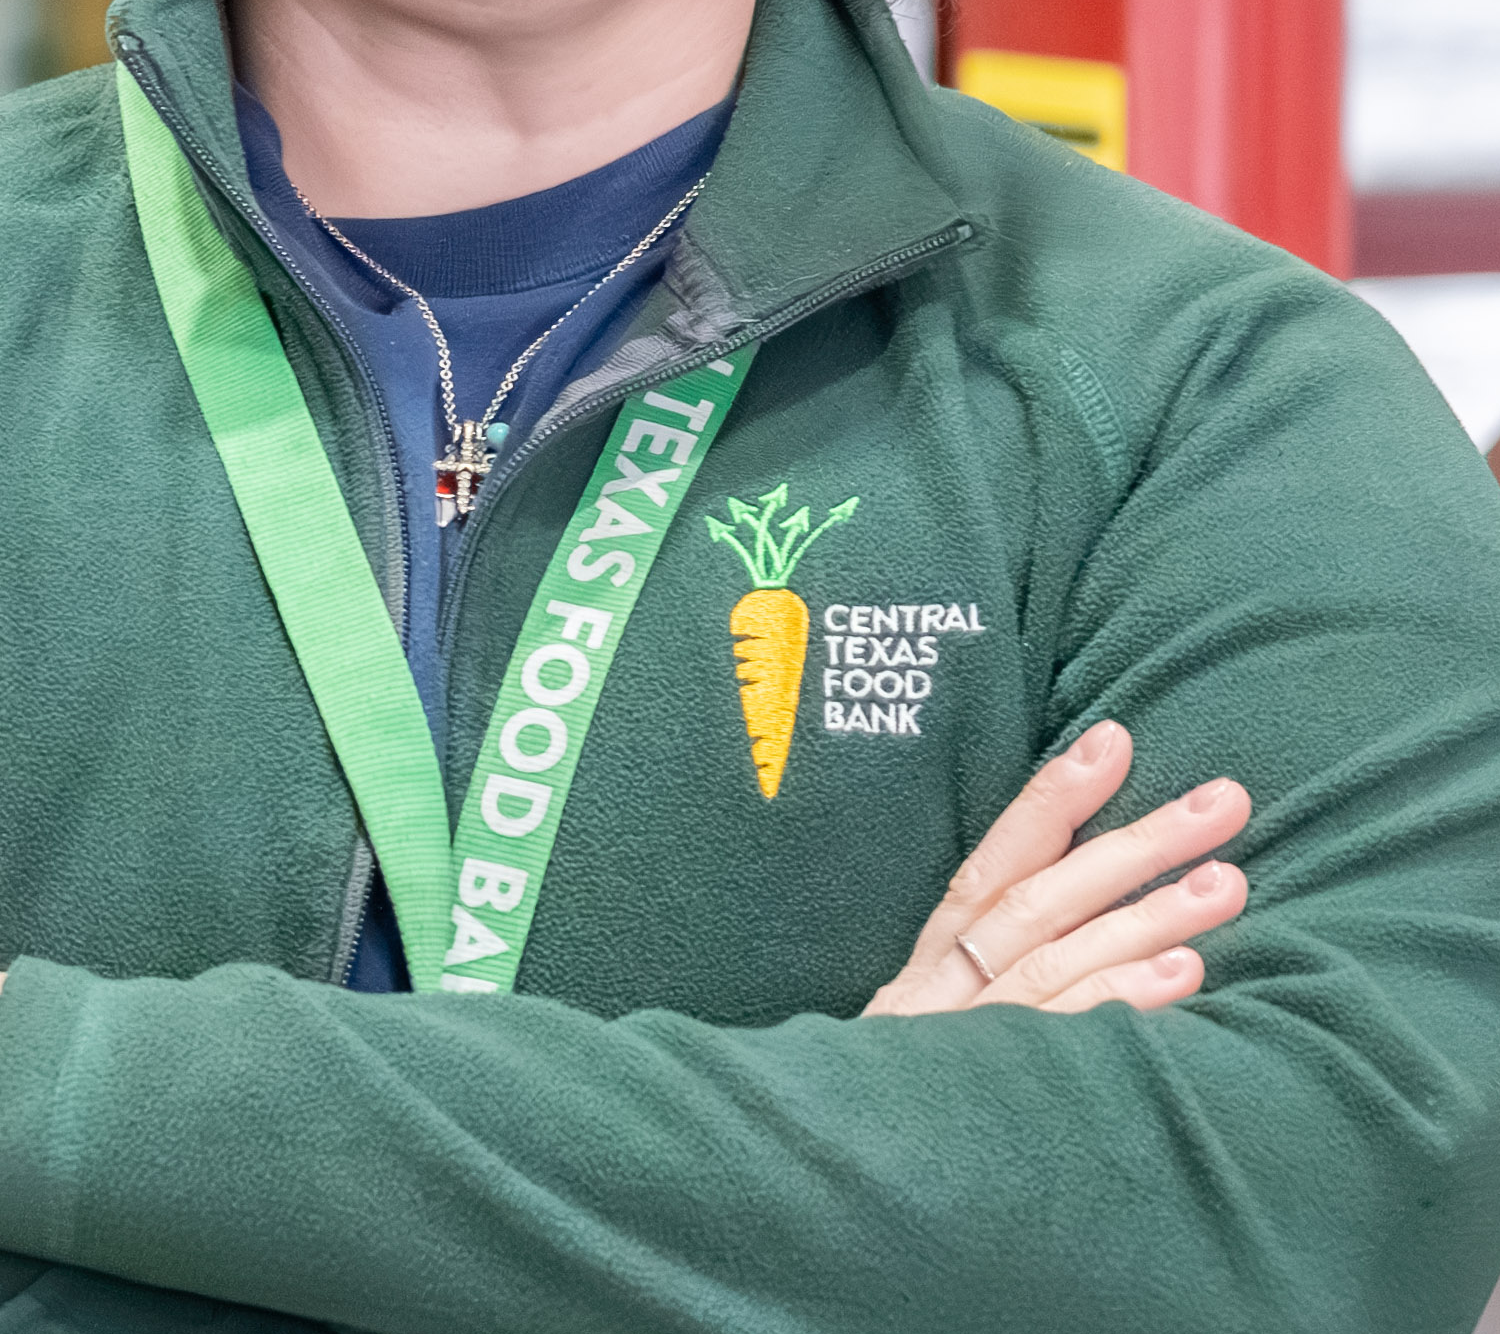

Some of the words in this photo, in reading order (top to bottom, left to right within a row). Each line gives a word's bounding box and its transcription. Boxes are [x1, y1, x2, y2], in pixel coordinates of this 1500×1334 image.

[566, 391, 715, 587] TEXAS
[824, 603, 987, 634] CENTRAL
[824, 635, 939, 667] TEXAS
[823, 668, 933, 700] FOOD
[481, 599, 613, 837] FOOD
[824, 701, 924, 735] BANK
[440, 857, 529, 993] BA
